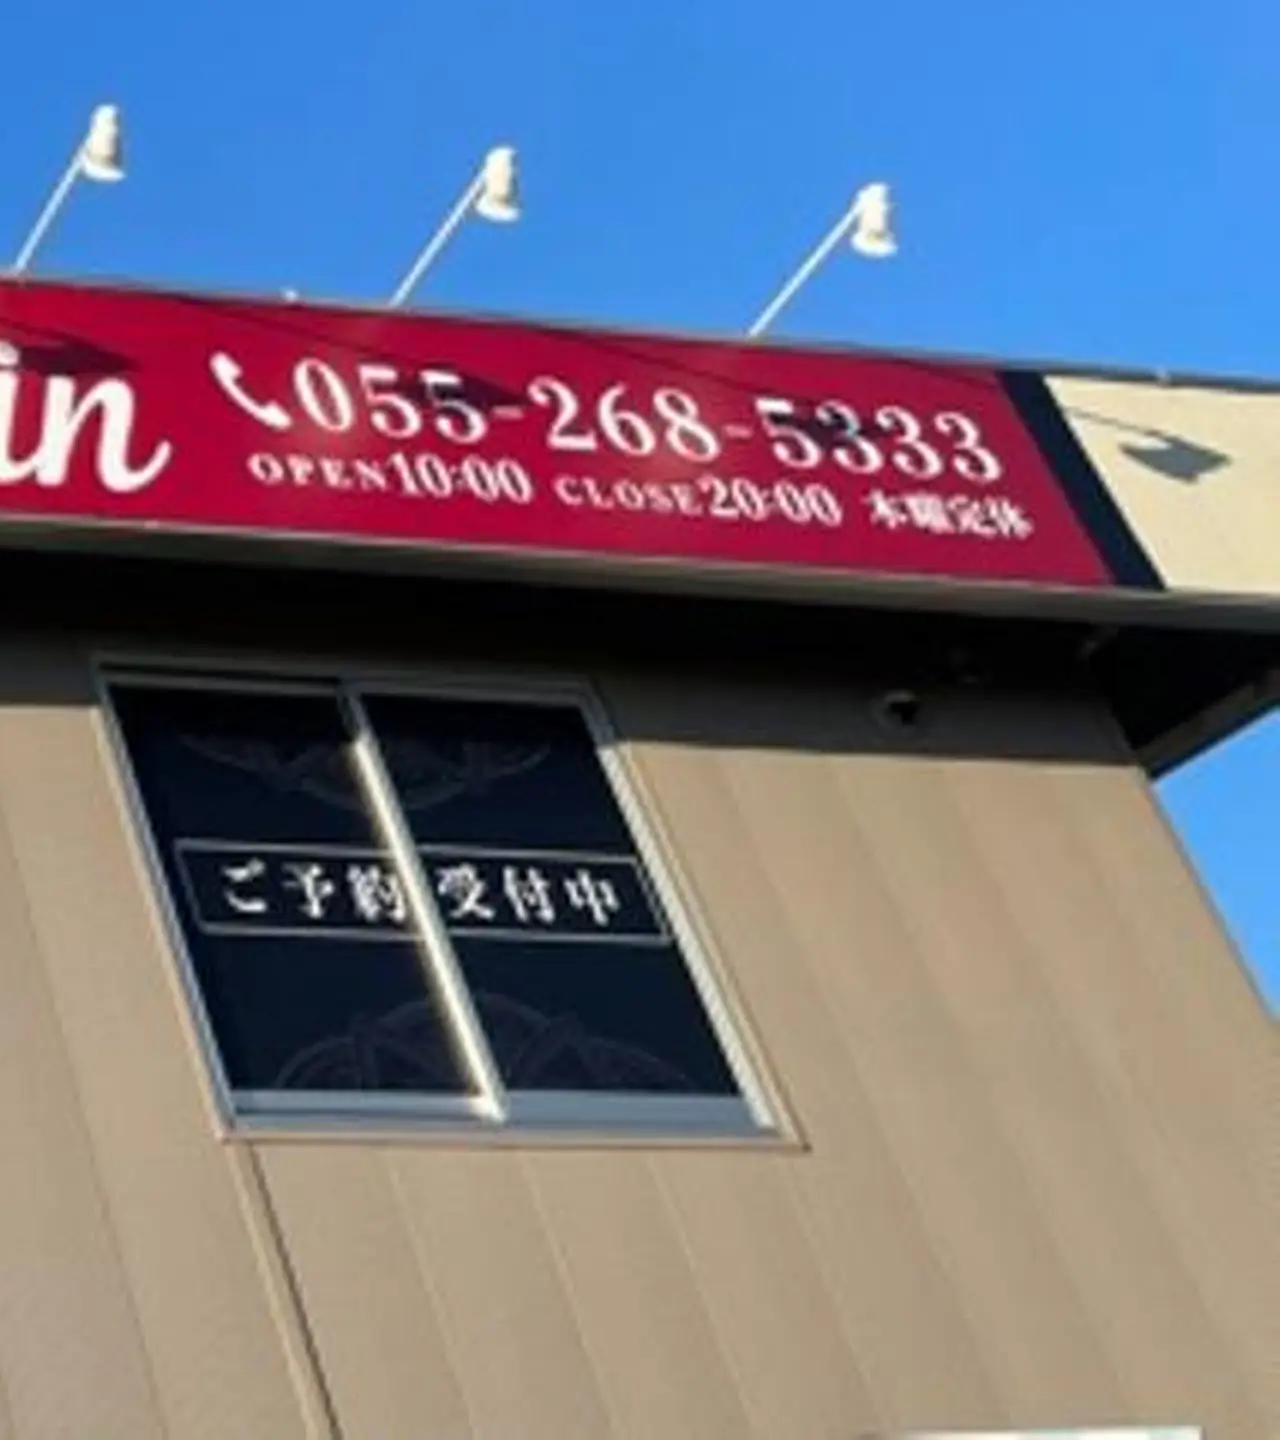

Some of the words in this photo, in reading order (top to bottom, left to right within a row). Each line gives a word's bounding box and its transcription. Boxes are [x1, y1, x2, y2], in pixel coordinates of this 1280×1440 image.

[292, 356, 1004, 484] 055-268-5333
[220, 857, 622, 927] ご予約受付中
